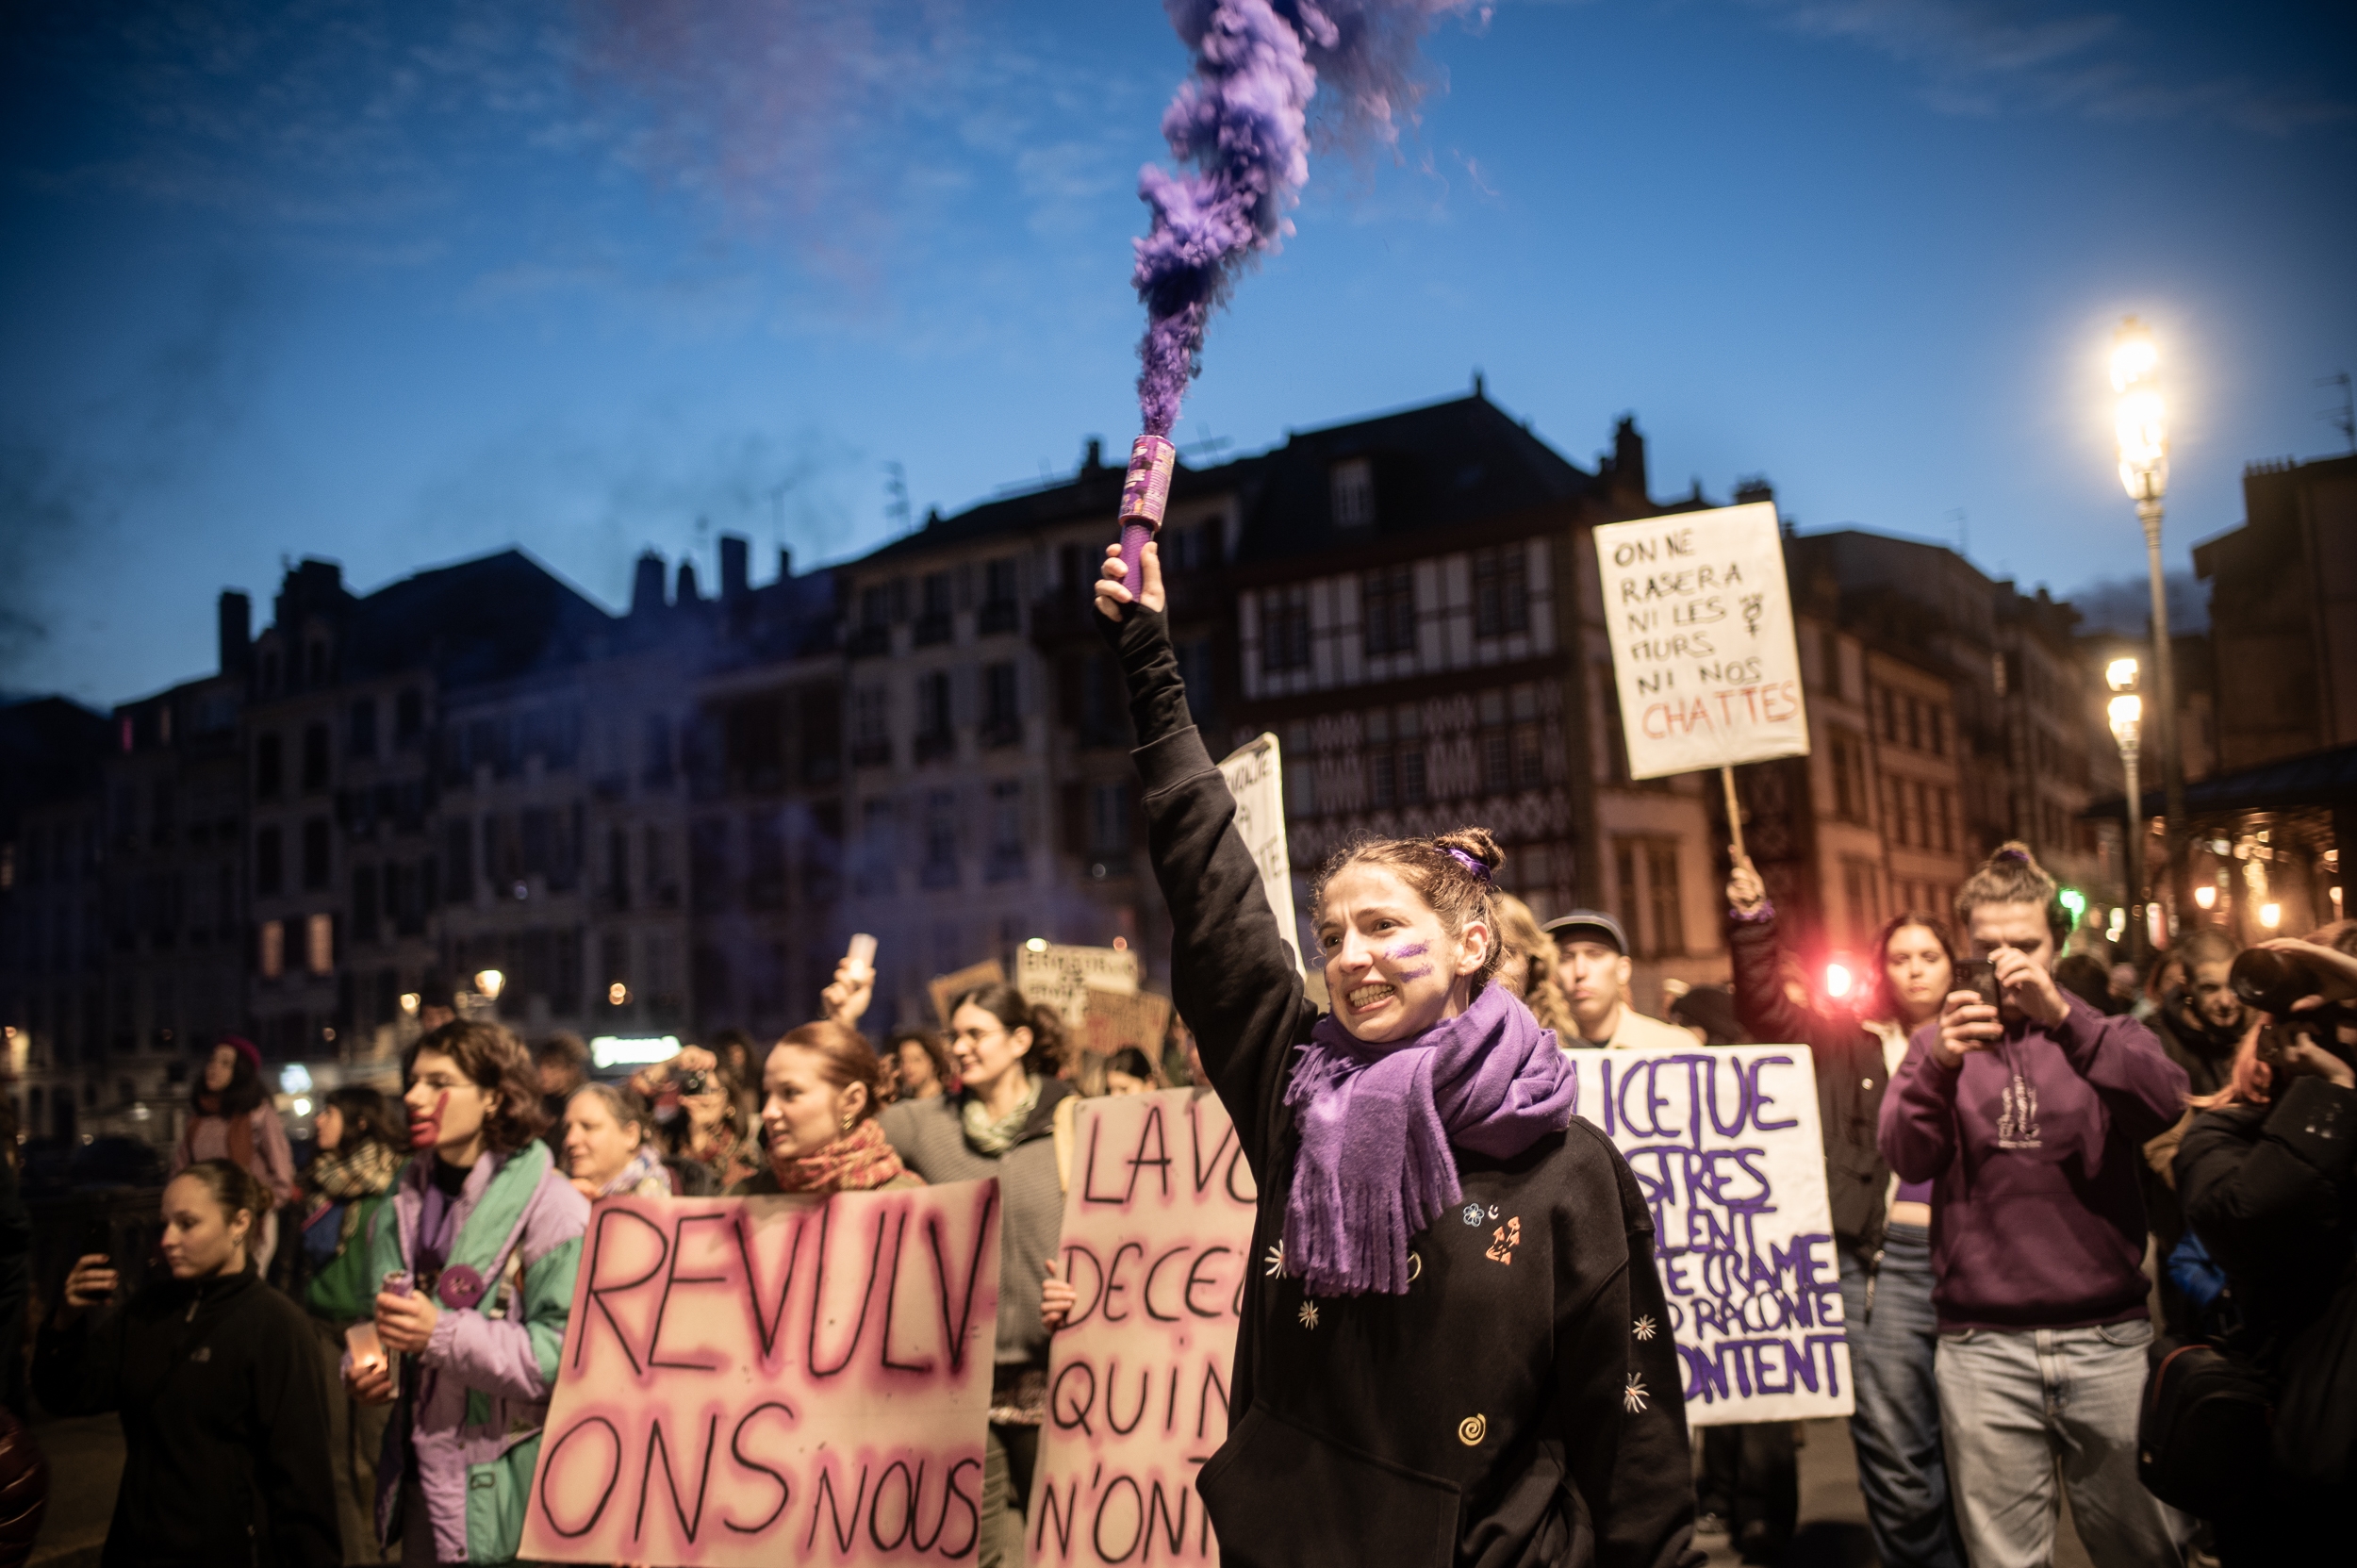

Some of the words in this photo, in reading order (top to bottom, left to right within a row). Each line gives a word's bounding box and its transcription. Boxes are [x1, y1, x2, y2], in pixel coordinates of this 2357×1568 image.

[1614, 541, 1656, 567] ON
[1666, 528, 1695, 559] NE
[1628, 609, 1659, 634] NI
[1673, 596, 1727, 626] LES
[1638, 670, 1673, 698] NI
[1700, 657, 1762, 685] NOS
[1641, 681, 1799, 739] CHATTES
[571, 1191, 997, 1379] REVULV
[540, 1402, 794, 1544] ONS
[806, 1457, 982, 1560] NOUS
